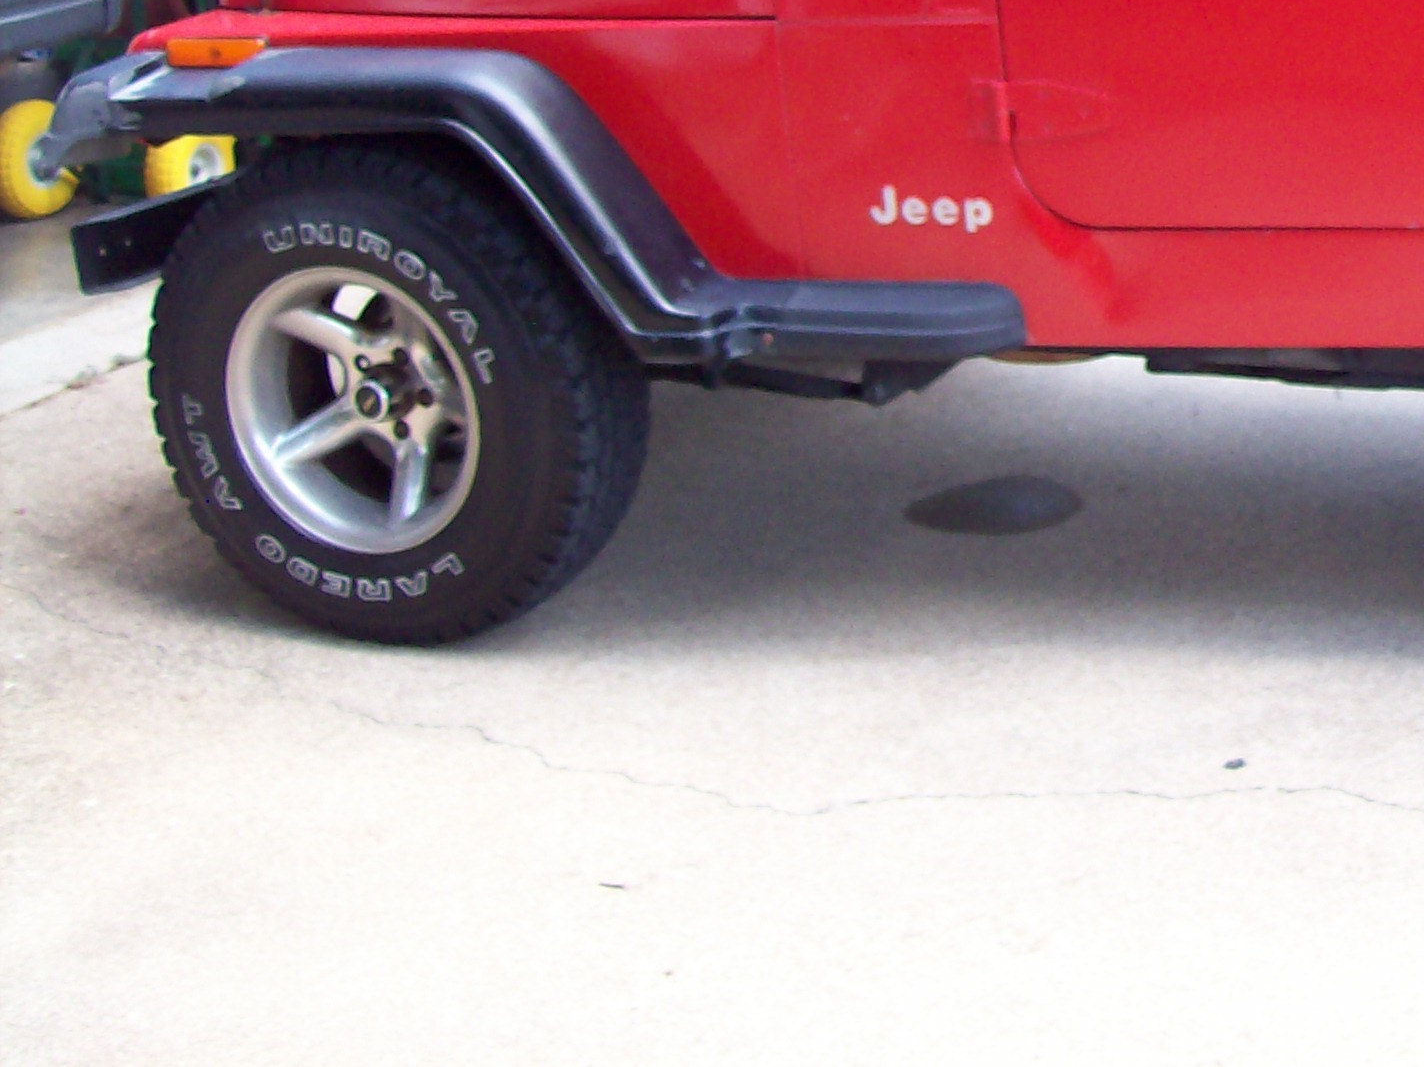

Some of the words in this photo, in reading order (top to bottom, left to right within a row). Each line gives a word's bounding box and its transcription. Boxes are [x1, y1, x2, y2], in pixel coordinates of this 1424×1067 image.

[870, 184, 993, 233] Jeep
[263, 222, 496, 384] UNIROYAL
[183, 398, 242, 511] AWT
[256, 533, 464, 603] LAREDO
